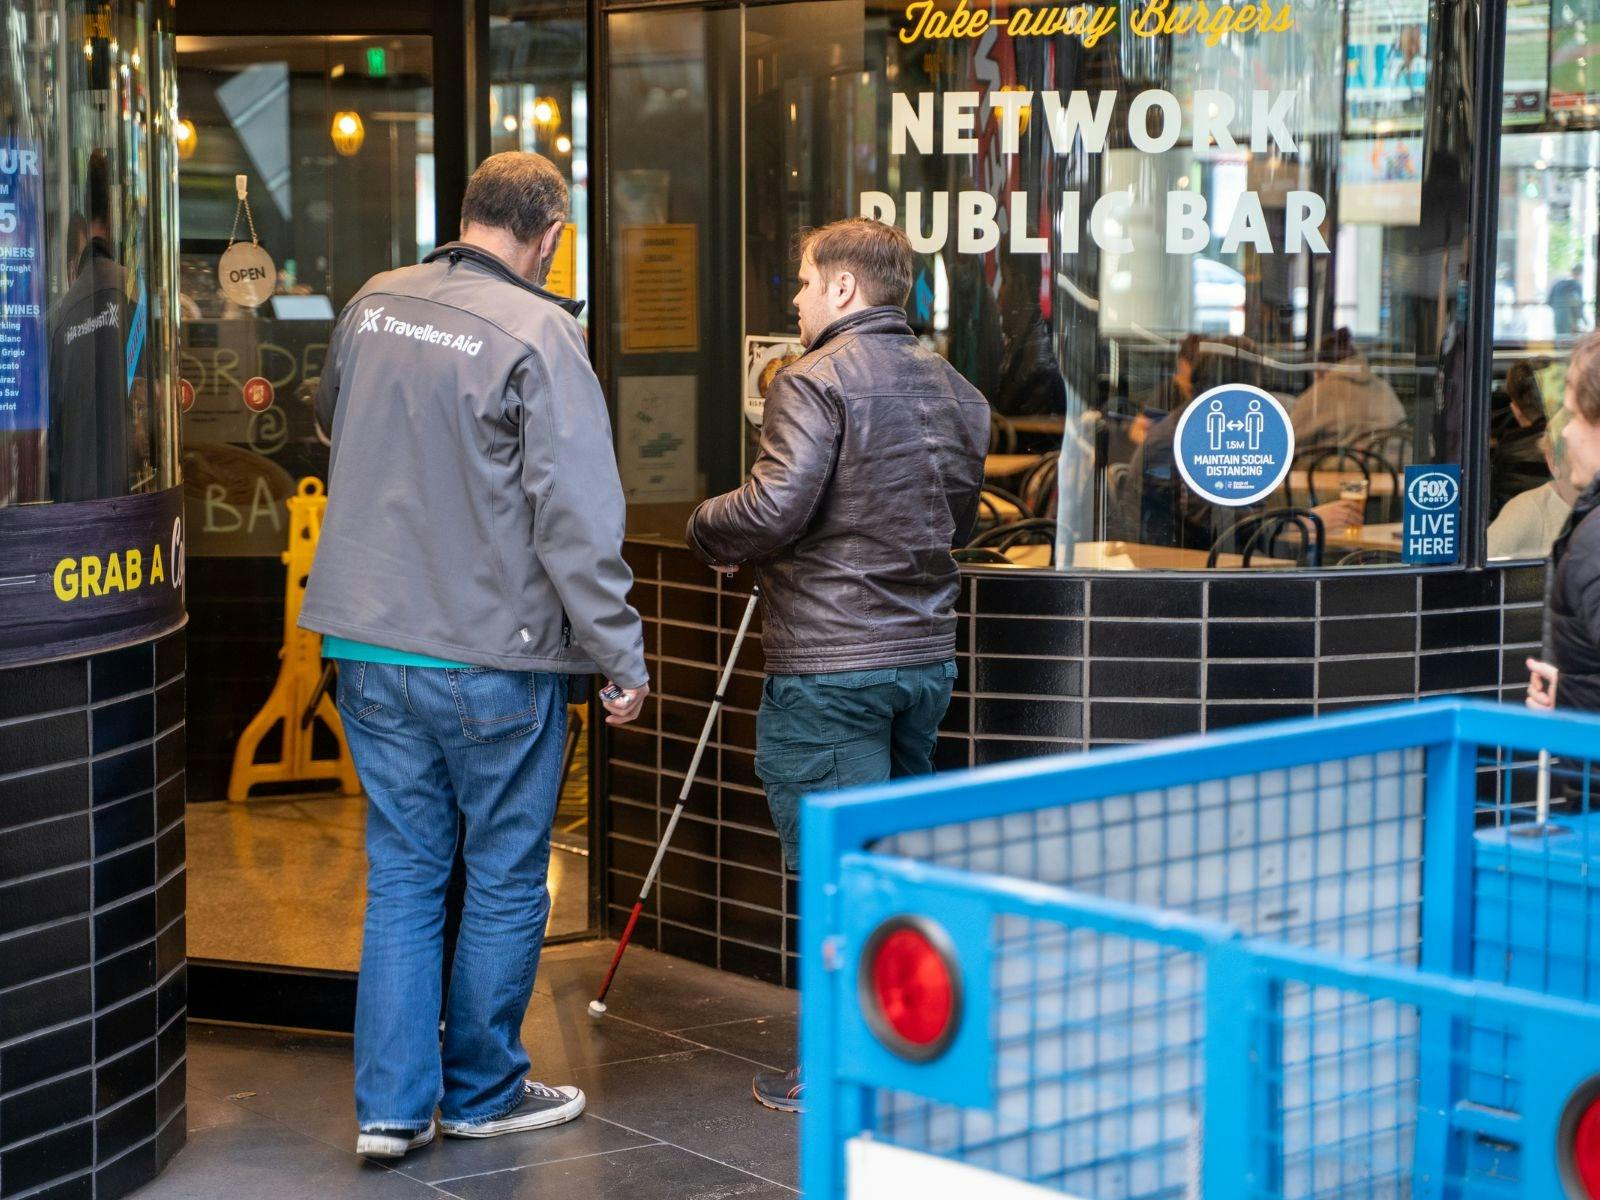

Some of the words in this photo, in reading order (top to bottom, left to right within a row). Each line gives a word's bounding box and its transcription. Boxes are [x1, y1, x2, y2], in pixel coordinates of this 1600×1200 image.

[899, 0, 1117, 48] Take-away
[1130, 0, 1294, 48] Burgers
[891, 89, 1299, 155] NETWORK
[860, 190, 1135, 254] PUBLIC
[1166, 190, 1331, 254] BAR
[229, 265, 267, 284] OPEN
[4, 304, 40, 315] WINES
[0, 334, 22, 342] Blanc
[383, 316, 454, 346] Travellers
[451, 334, 483, 356] Aid
[4, 389, 20, 397] Sav
[1194, 455, 1240, 465] MAINTAIN
[1241, 455, 1275, 465] SOCIAL
[1206, 466, 1263, 476] DISTANCING
[1418, 480, 1448, 497] FOX
[1410, 514, 1455, 535] LIVE
[1409, 537, 1454, 556] HERE
[53, 549, 143, 602] GRAB
[149, 543, 165, 585] A
